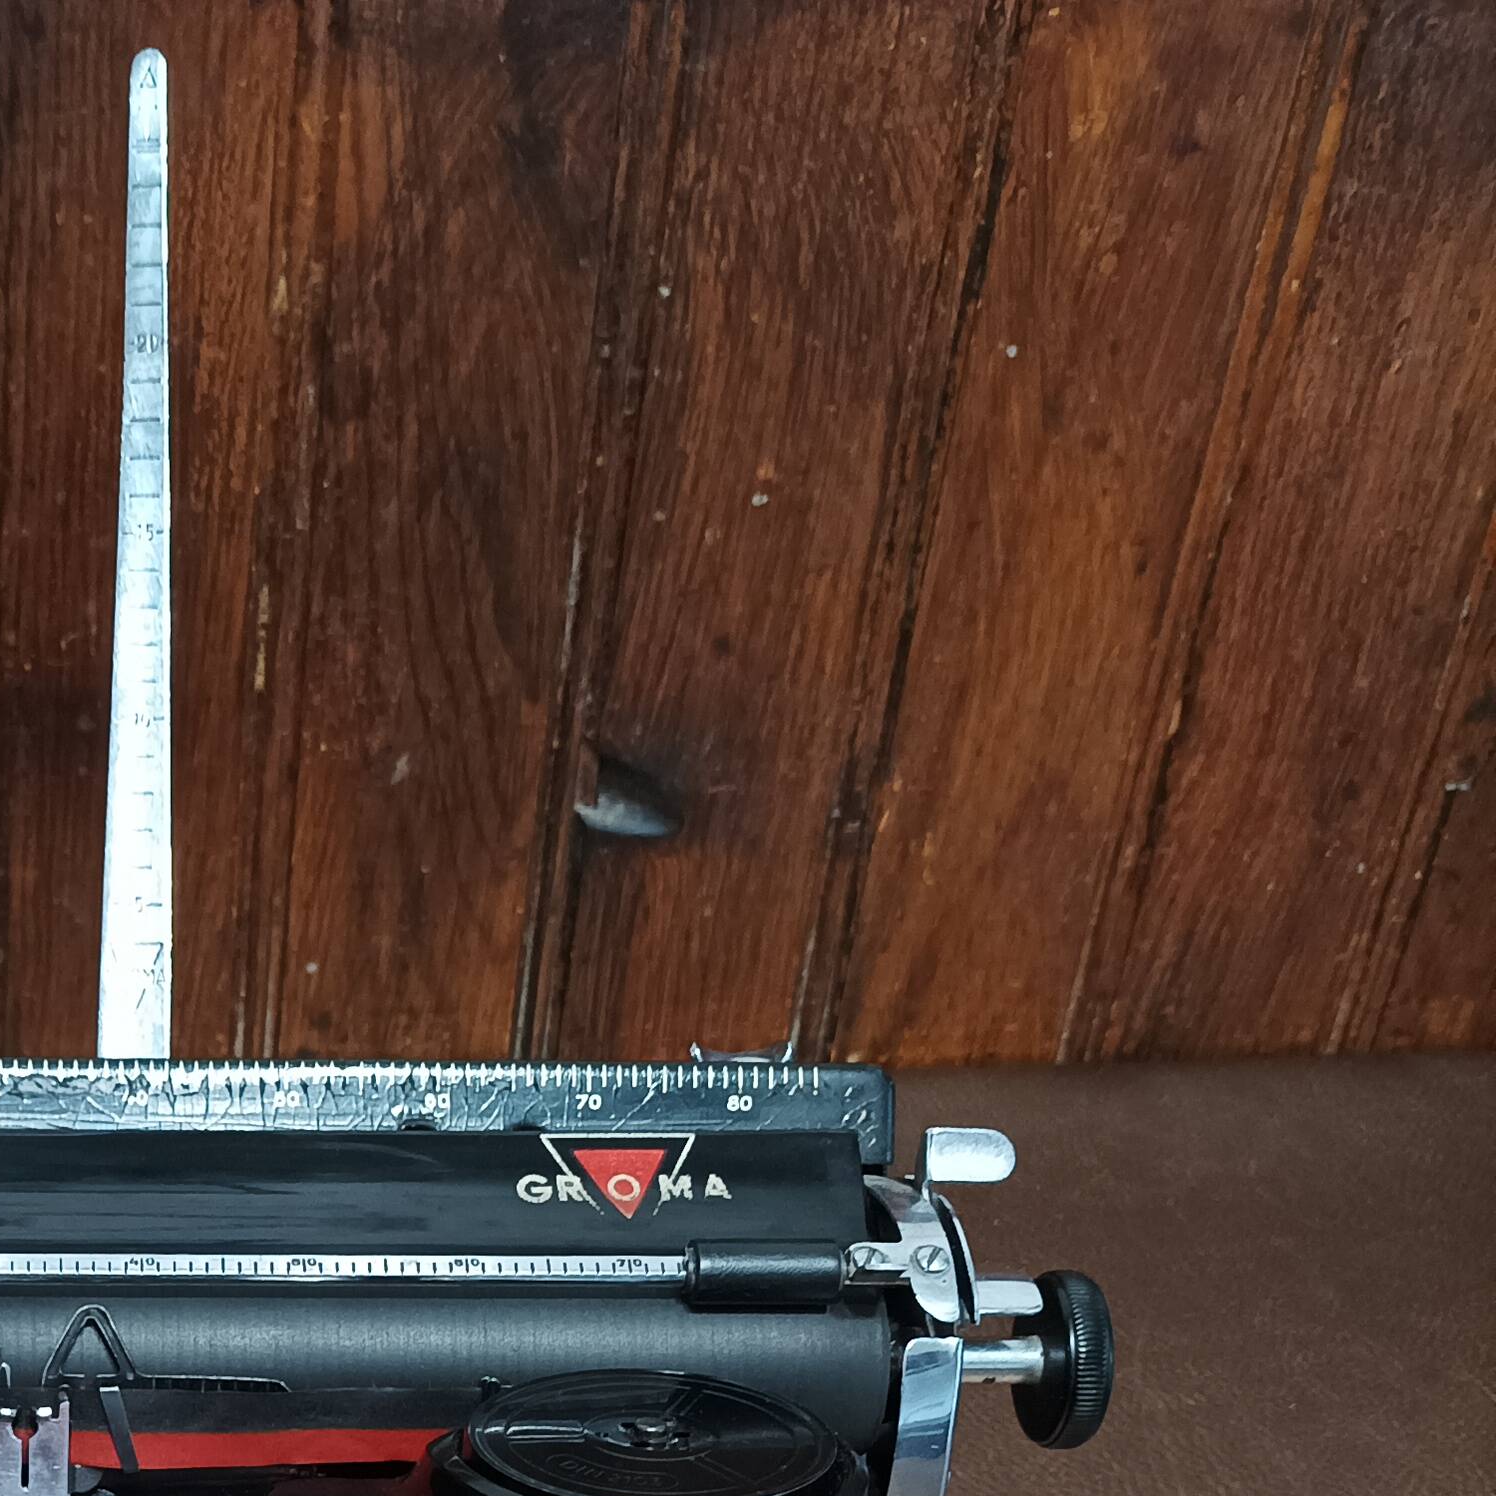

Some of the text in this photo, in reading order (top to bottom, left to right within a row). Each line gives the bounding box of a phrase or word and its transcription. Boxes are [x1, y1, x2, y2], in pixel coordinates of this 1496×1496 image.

[575, 1093, 602, 1111] 70
[726, 1094, 753, 1112] 80
[515, 1173, 733, 1204] GROMA
